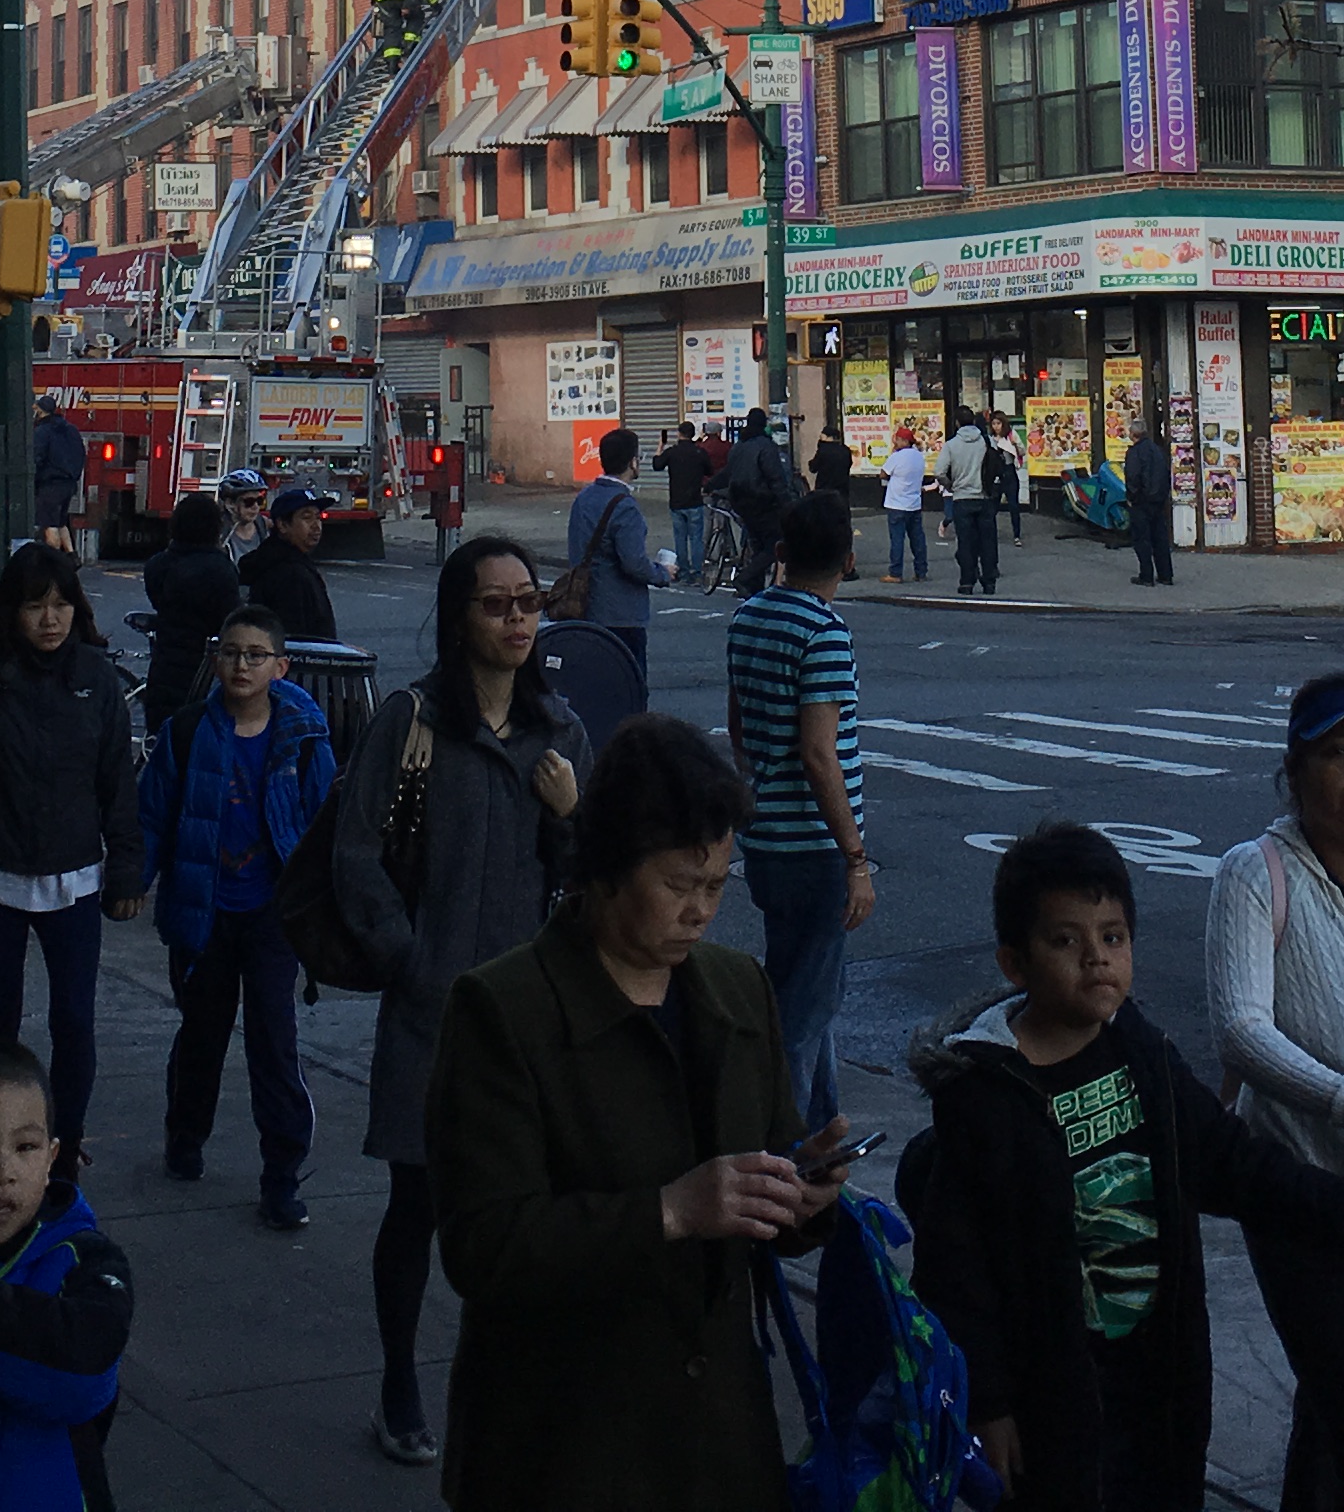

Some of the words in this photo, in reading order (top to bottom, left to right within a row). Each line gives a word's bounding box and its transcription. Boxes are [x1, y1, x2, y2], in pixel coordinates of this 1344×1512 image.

[772, 39, 797, 48] ROUTE
[754, 74, 798, 84] SHARED
[761, 87, 790, 97] LANE
[1126, 32, 1146, 168] ACCIDENTES
[927, 44, 950, 173] DIVORCIOS
[1164, 39, 1187, 168] ACCIDENTS
[786, 103, 806, 214] IGRACION
[747, 209, 754, 225] 5
[1134, 219, 1158, 228] 3900
[678, 221, 707, 235] PARTS
[792, 227, 810, 244] 39
[815, 226, 829, 239] ST
[1094, 229, 1144, 238] LANDMARK
[1150, 228, 1201, 238] MINI-MART
[1236, 229, 1289, 242] LANDMARK
[1290, 231, 1341, 244] MINI-MART
[654, 238, 719, 272] Supply
[718, 232, 756, 261] Inc.
[960, 235, 1043, 260] BUFFET
[1044, 238, 1056, 248] FREE
[1057, 236, 1084, 248] DELIVERY
[1230, 243, 1271, 268] DELI
[787, 257, 836, 274] LANDMARK
[837, 254, 883, 269] MINI-MART
[943, 261, 985, 278] SPANISH
[985, 255, 1040, 274] AMERICAN
[1041, 252, 1081, 269] FOOD
[659, 266, 752, 290] FAX:718-686-7088
[785, 271, 821, 295] DELI
[824, 266, 907, 292] GROCERY
[981, 276, 1001, 288] FOOD
[1051, 268, 1085, 282] CHICKEN
[1101, 274, 1196, 286] 347-725-3410
[587, 281, 610, 296] AVE.
[956, 289, 977, 301] FRESH
[979, 287, 1000, 299] JUICE
[1004, 285, 1027, 297] FRESH
[1027, 283, 1049, 295] FRUIT
[1050, 280, 1074, 293] SALAD
[1200, 310, 1233, 326] Halal
[1198, 326, 1236, 342] Buffet
[259, 385, 319, 405] LADDER
[288, 407, 336, 428] FDNY
[844, 403, 861, 417] LUNCH
[862, 402, 889, 417] SPECIAL
